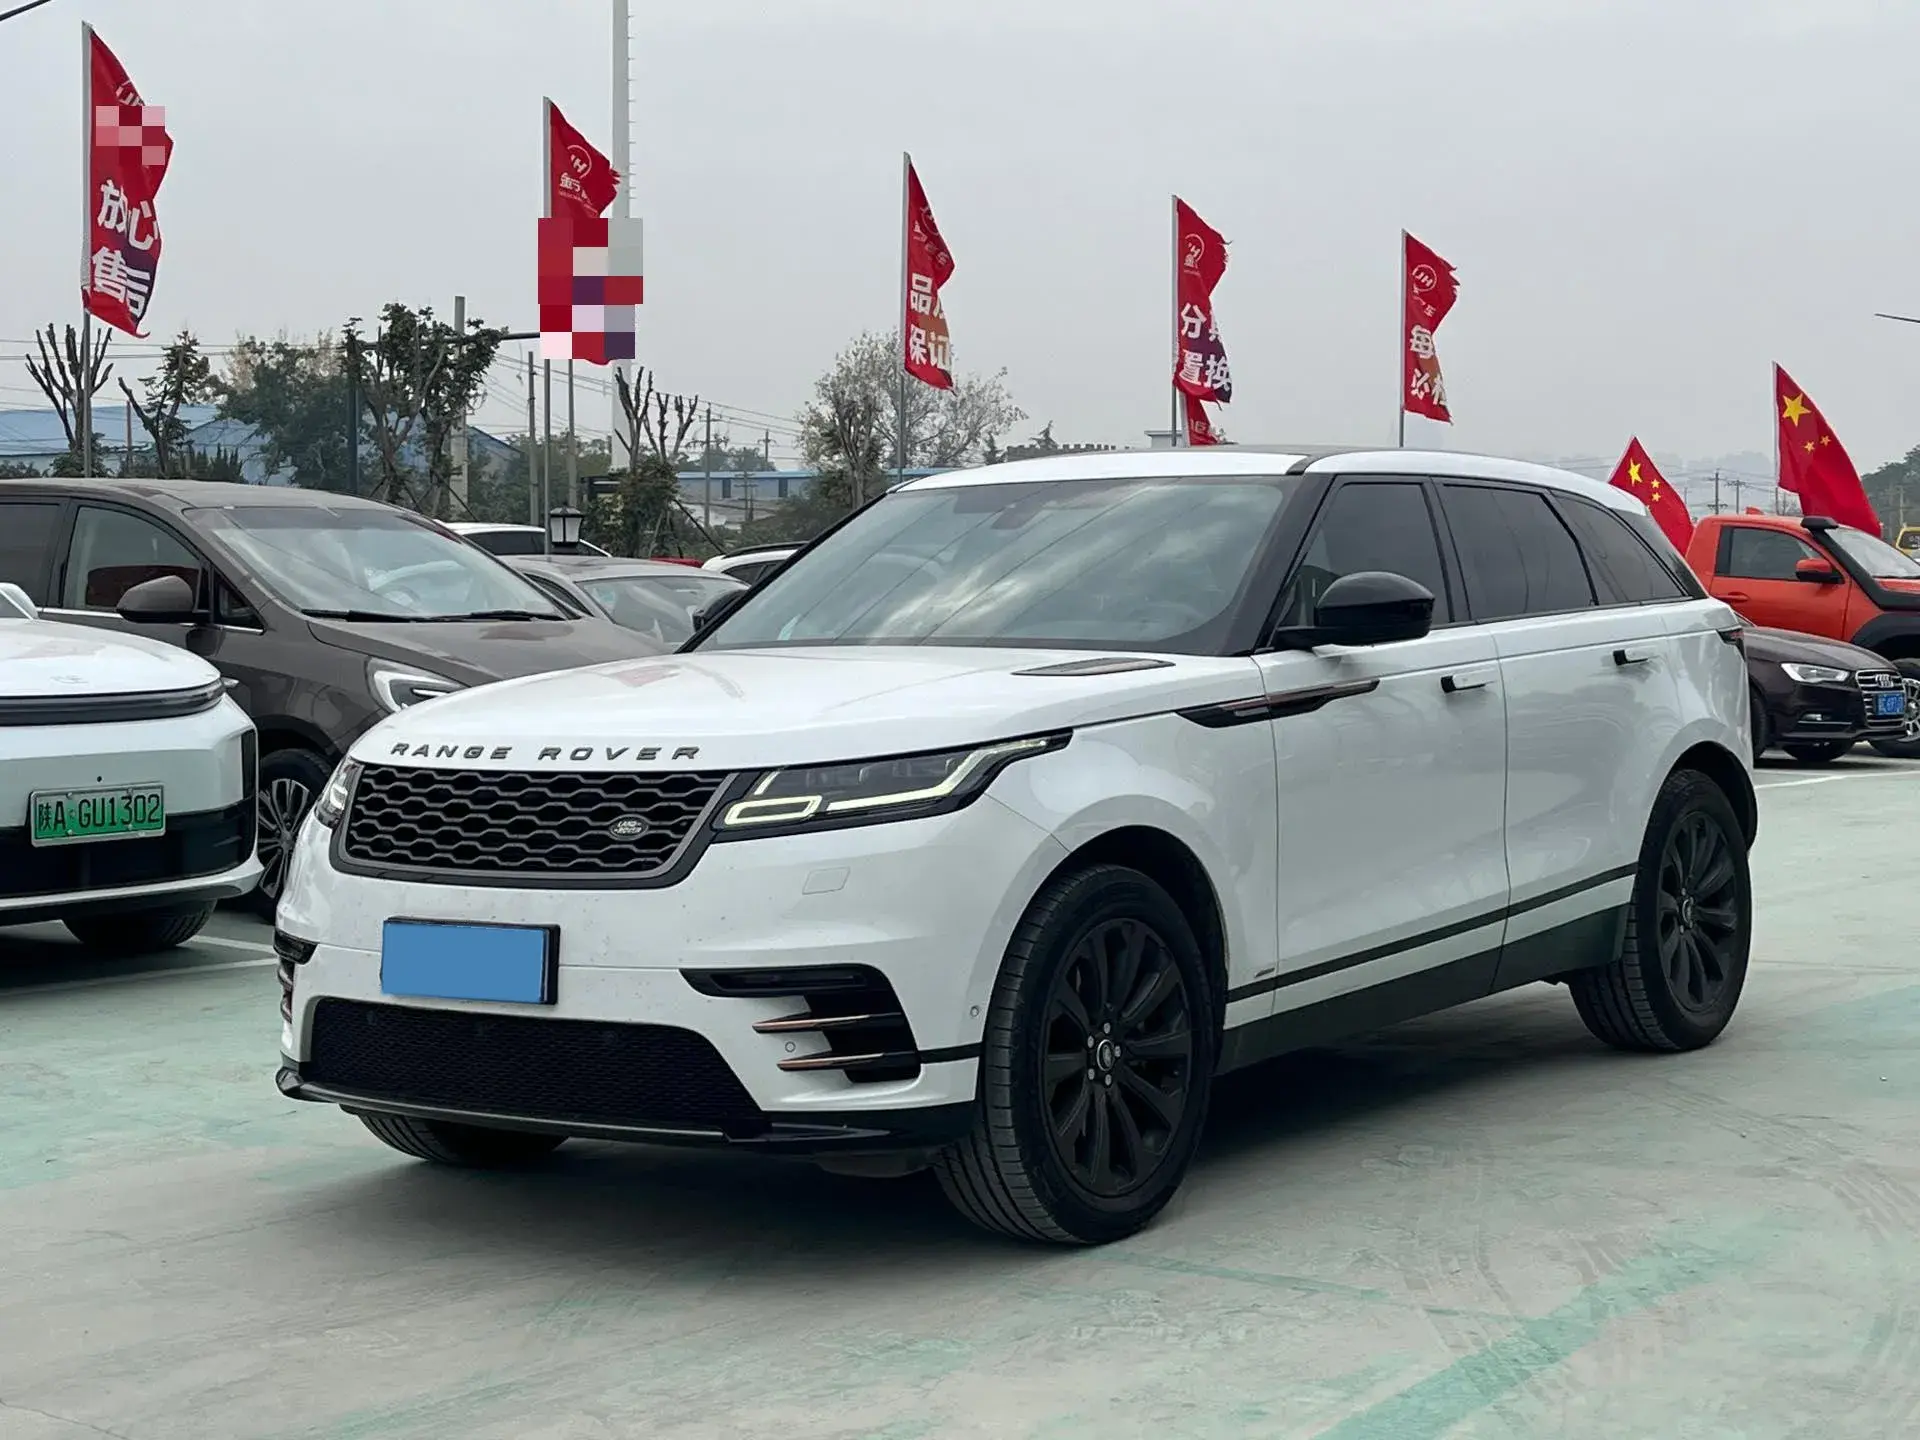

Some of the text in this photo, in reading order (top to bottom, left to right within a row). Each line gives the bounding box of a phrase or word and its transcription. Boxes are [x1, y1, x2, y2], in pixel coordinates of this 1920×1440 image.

[97, 179, 158, 251] 放心
[910, 272, 944, 318] 品
[1179, 349, 1231, 392] 置换
[390, 742, 700, 761] RANGE ROVER
